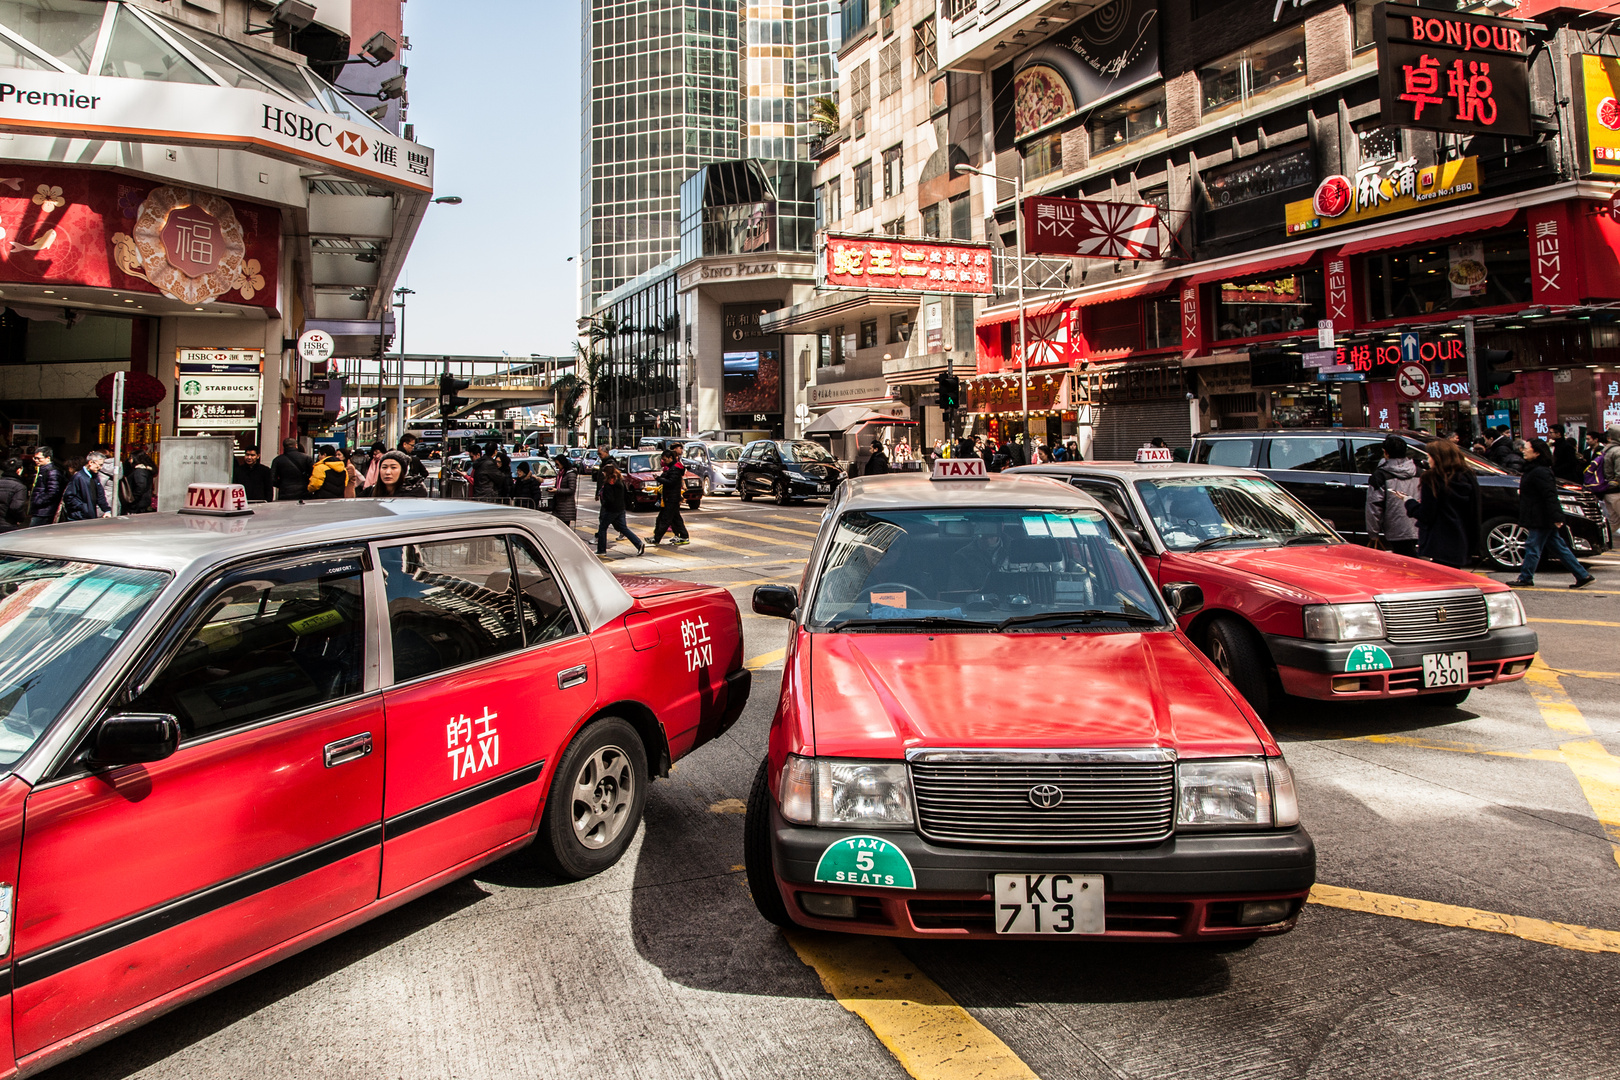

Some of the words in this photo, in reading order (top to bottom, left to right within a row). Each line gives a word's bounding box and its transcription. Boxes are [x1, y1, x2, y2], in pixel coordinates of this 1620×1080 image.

[1411, 16, 1524, 53] BONJOUR
[1068, 35, 1087, 58] Share
[1089, 57, 1100, 70] slice
[1100, 60, 1112, 77] of
[0, 82, 101, 110] Premier
[262, 103, 333, 148] HSBC
[1416, 191, 1437, 202] Korea
[1438, 186, 1455, 197] No.1
[1456, 182, 1473, 193] BBQ
[1037, 203, 1075, 221] 美心
[1037, 220, 1075, 238] MX
[175, 216, 214, 265] 福
[701, 266, 732, 279] SINO
[736, 262, 778, 276] PLAZA
[833, 245, 929, 277] 蛇王二
[304, 342, 329, 350] HSBC
[1377, 339, 1466, 366] BOOUR
[187, 353, 213, 361] HSBC
[1443, 383, 1471, 396] BON
[754, 414, 767, 422] ISA
[1145, 450, 1169, 460] TAXI
[939, 462, 983, 476] TAXI
[187, 487, 226, 509] TAXI
[231, 488, 245, 510] 的士
[328, 565, 352, 574] COMFORT
[680, 615, 711, 649] 的士
[684, 643, 713, 673] TAXI
[1355, 663, 1384, 671] SEATS
[1364, 652, 1374, 664] 5
[1428, 666, 1465, 686] 2501
[446, 706, 498, 749] 的士
[447, 734, 499, 781] TAXI
[846, 838, 886, 852] TAXI
[856, 851, 875, 872] 5
[835, 871, 895, 886] SEATS
[1025, 875, 1074, 904] KC
[1000, 903, 1075, 933] 713
